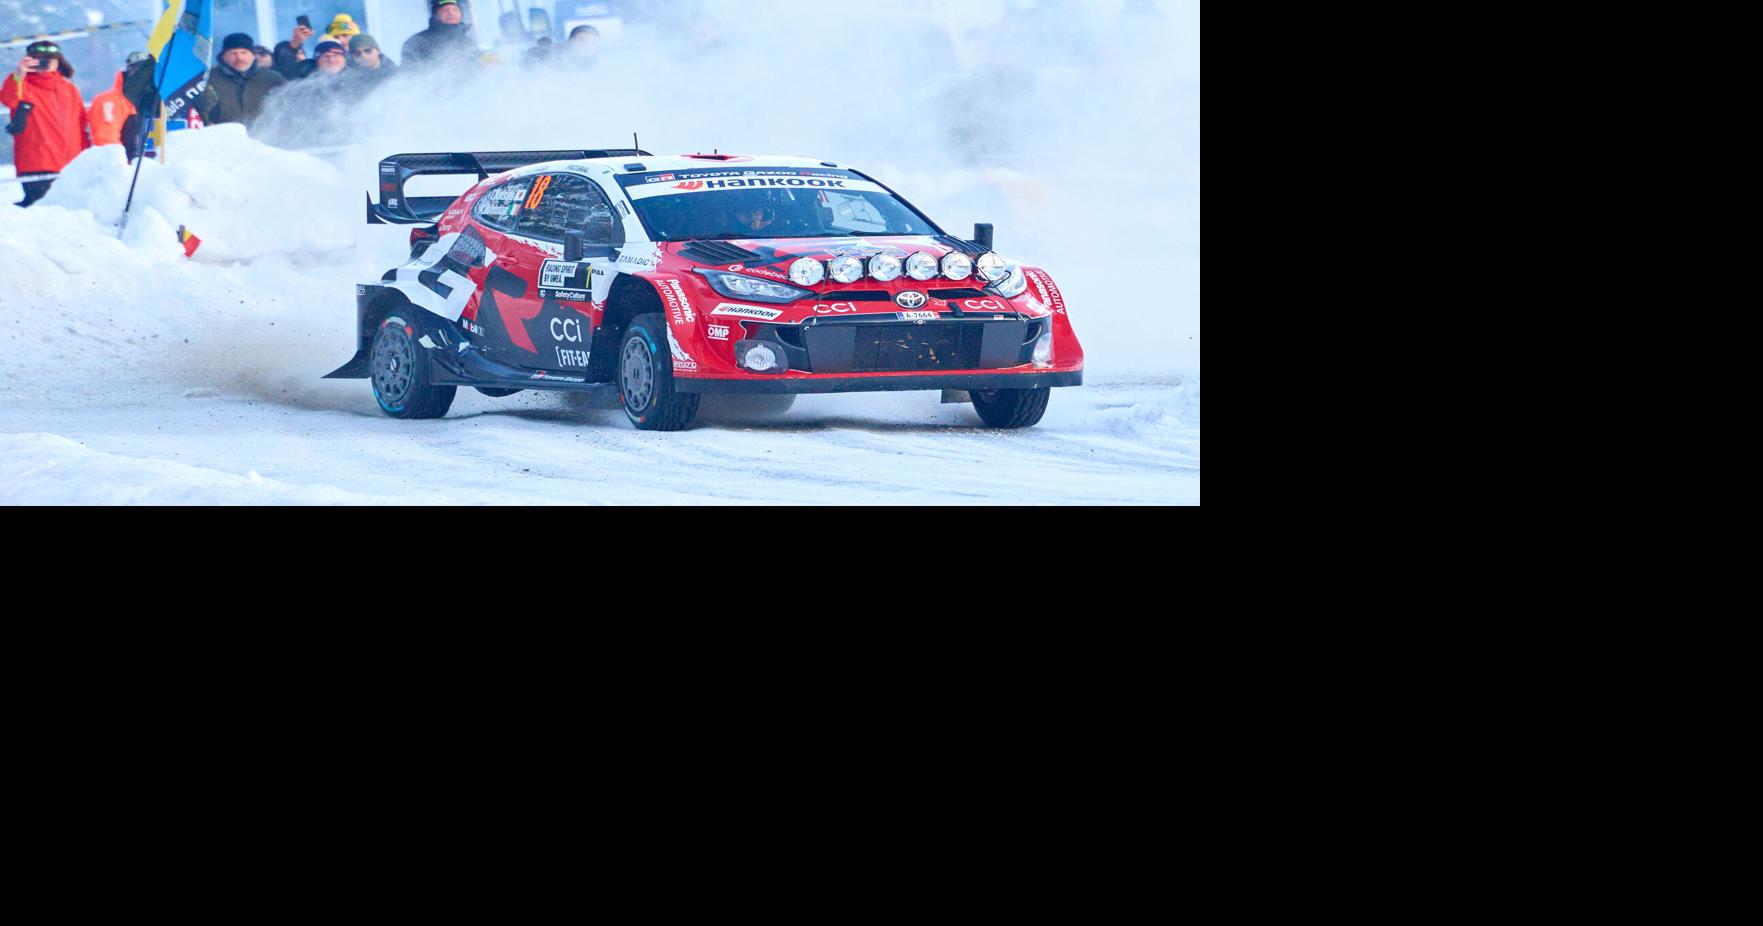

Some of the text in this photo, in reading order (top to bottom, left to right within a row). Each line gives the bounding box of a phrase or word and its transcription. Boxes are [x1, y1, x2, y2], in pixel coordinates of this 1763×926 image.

[677, 171, 740, 179] TOYOTA
[743, 169, 797, 177] GAZOO
[525, 175, 552, 209] 18
[619, 254, 650, 266] TAMADIC
[561, 264, 576, 275] SPIRIT
[655, 279, 684, 325] AUTOMOTIVE
[667, 279, 695, 323] Panasonic
[708, 327, 729, 338] OMP
